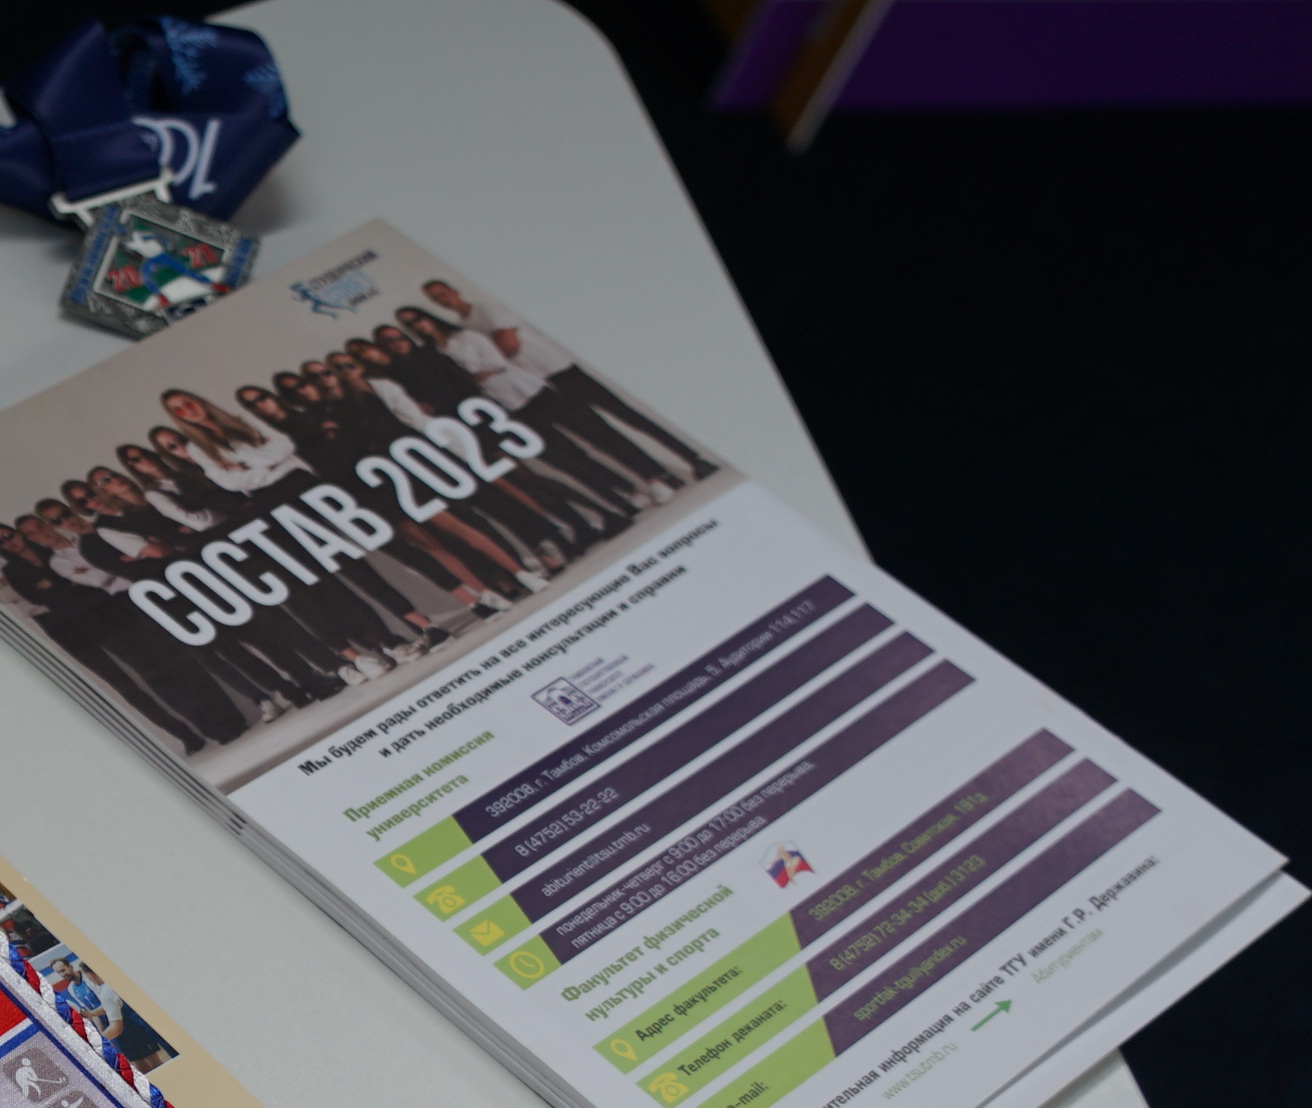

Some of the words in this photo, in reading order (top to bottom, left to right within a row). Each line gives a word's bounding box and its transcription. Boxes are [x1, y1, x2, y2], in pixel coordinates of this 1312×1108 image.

[128, 484, 395, 647] СОСТАВ
[355, 396, 546, 525] 2023
[297, 756, 333, 777] Мы
[328, 728, 379, 757] будем
[376, 705, 419, 735] рады
[415, 667, 483, 709] ответить
[479, 653, 502, 671] на
[498, 638, 529, 660] все
[527, 572, 631, 643] интересующие
[626, 556, 659, 578] Вас
[656, 518, 720, 560] вопросы
[378, 746, 394, 759] и
[390, 728, 427, 754] дать
[423, 668, 524, 732] необходимые
[582, 702, 666, 757] Комсомольская
[342, 772, 425, 824] Приемная
[366, 773, 470, 842] университета
[514, 843, 529, 858] 8
[525, 819, 571, 853] (4752)
[561, 786, 622, 829] 53-22-22
[662, 854, 675, 866] с
[667, 836, 701, 861] 9:00
[696, 829, 715, 846] до
[615, 910, 627, 922] с
[619, 890, 652, 917] 9:00
[648, 884, 666, 900] до
[571, 916, 619, 949] пятница
[665, 926, 722, 968] спорта
[634, 1012, 676, 1043] Адрес
[672, 965, 744, 1018] факультета:
[877, 1013, 956, 1073] информация
[952, 1000, 973, 1018] на
[968, 974, 1006, 1006] сайте
[999, 953, 1028, 978] ТГУ
[1027, 926, 1068, 959] имени
[676, 1037, 734, 1078] Телефон
[730, 999, 789, 1045] деканата:
